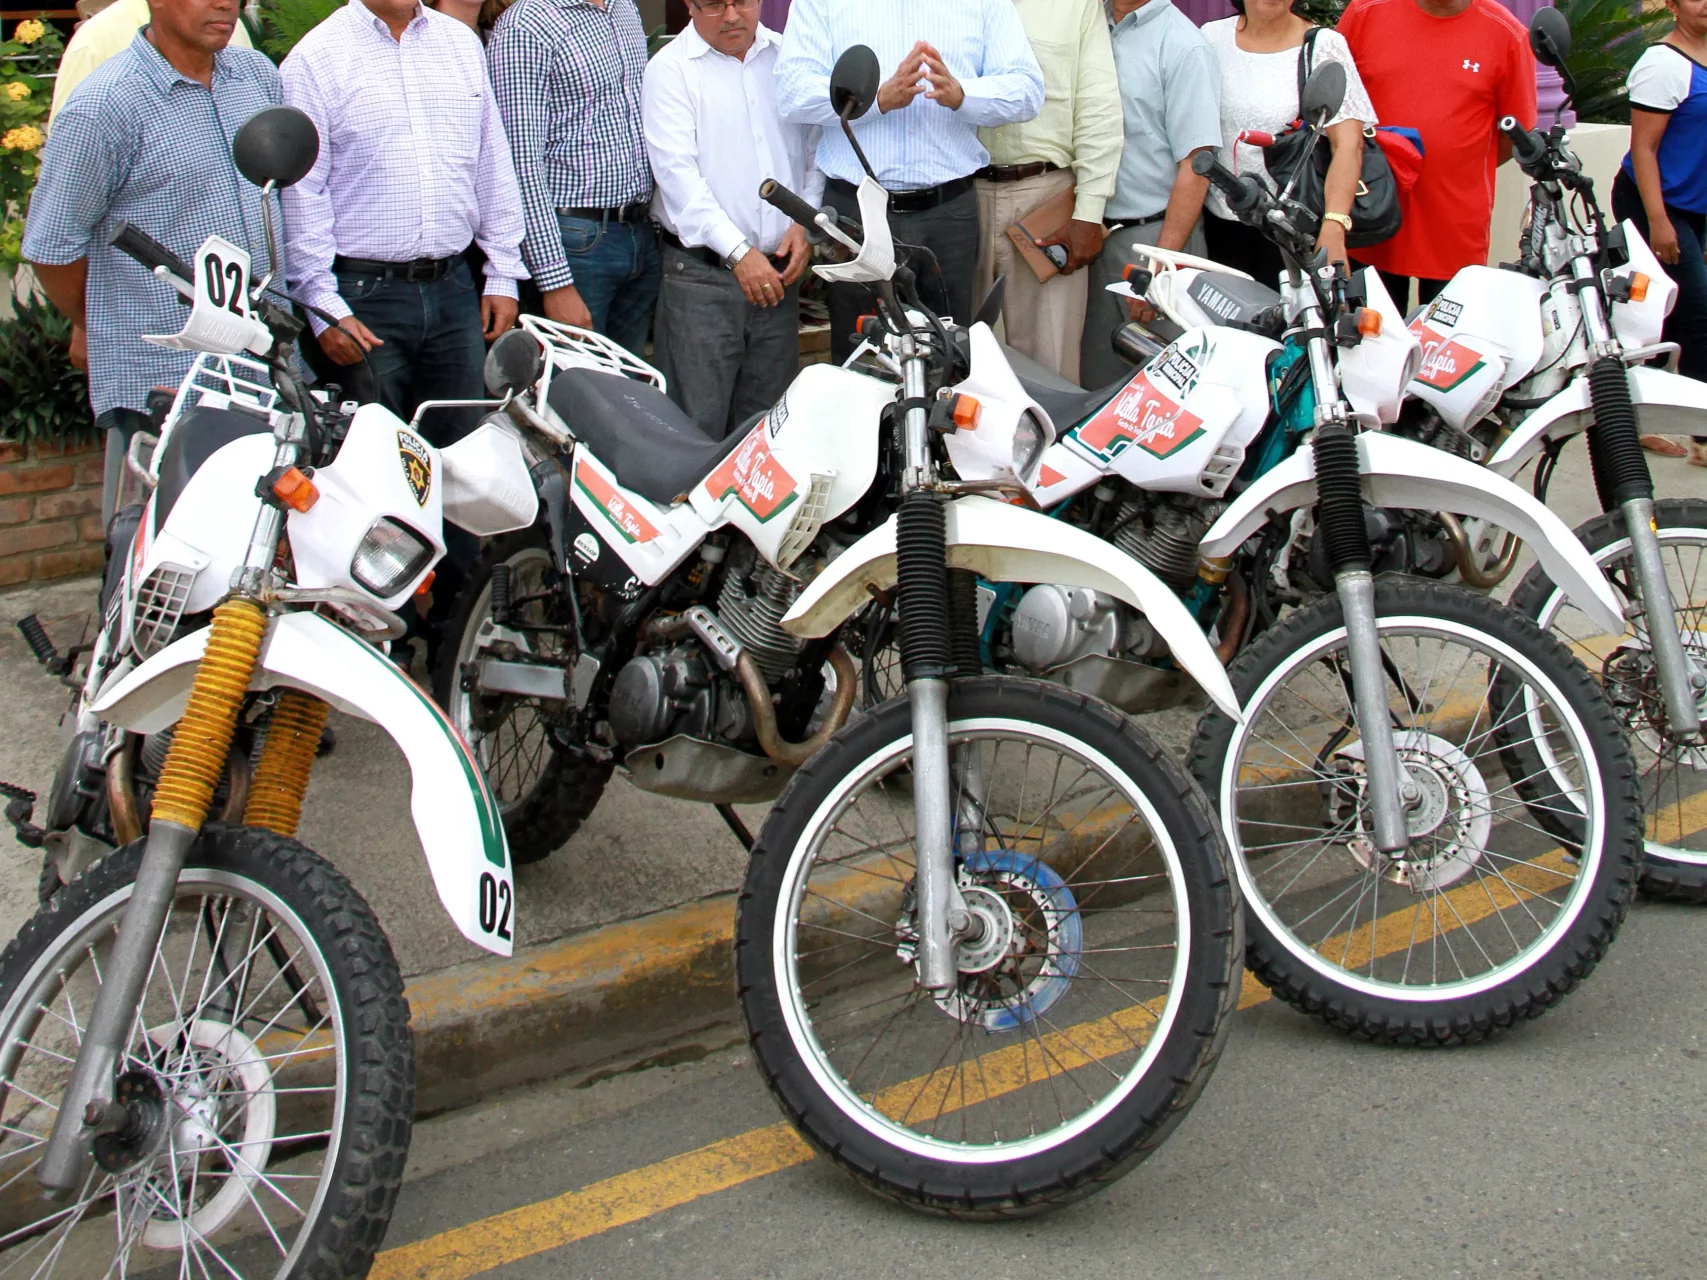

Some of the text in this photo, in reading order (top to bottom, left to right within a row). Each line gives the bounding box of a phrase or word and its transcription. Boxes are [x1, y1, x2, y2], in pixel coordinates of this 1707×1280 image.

[204, 252, 244, 318] 02
[1197, 283, 1242, 320] YAMAHA
[1169, 351, 1196, 379] POLICIA
[1113, 389, 1175, 444] Villa Tapia
[398, 432, 429, 466] POLICIA
[748, 451, 775, 504] Tapia
[607, 497, 625, 520] Villa
[623, 512, 641, 537] Tapia
[576, 539, 597, 556] DUNLOP
[480, 871, 512, 942] 02
